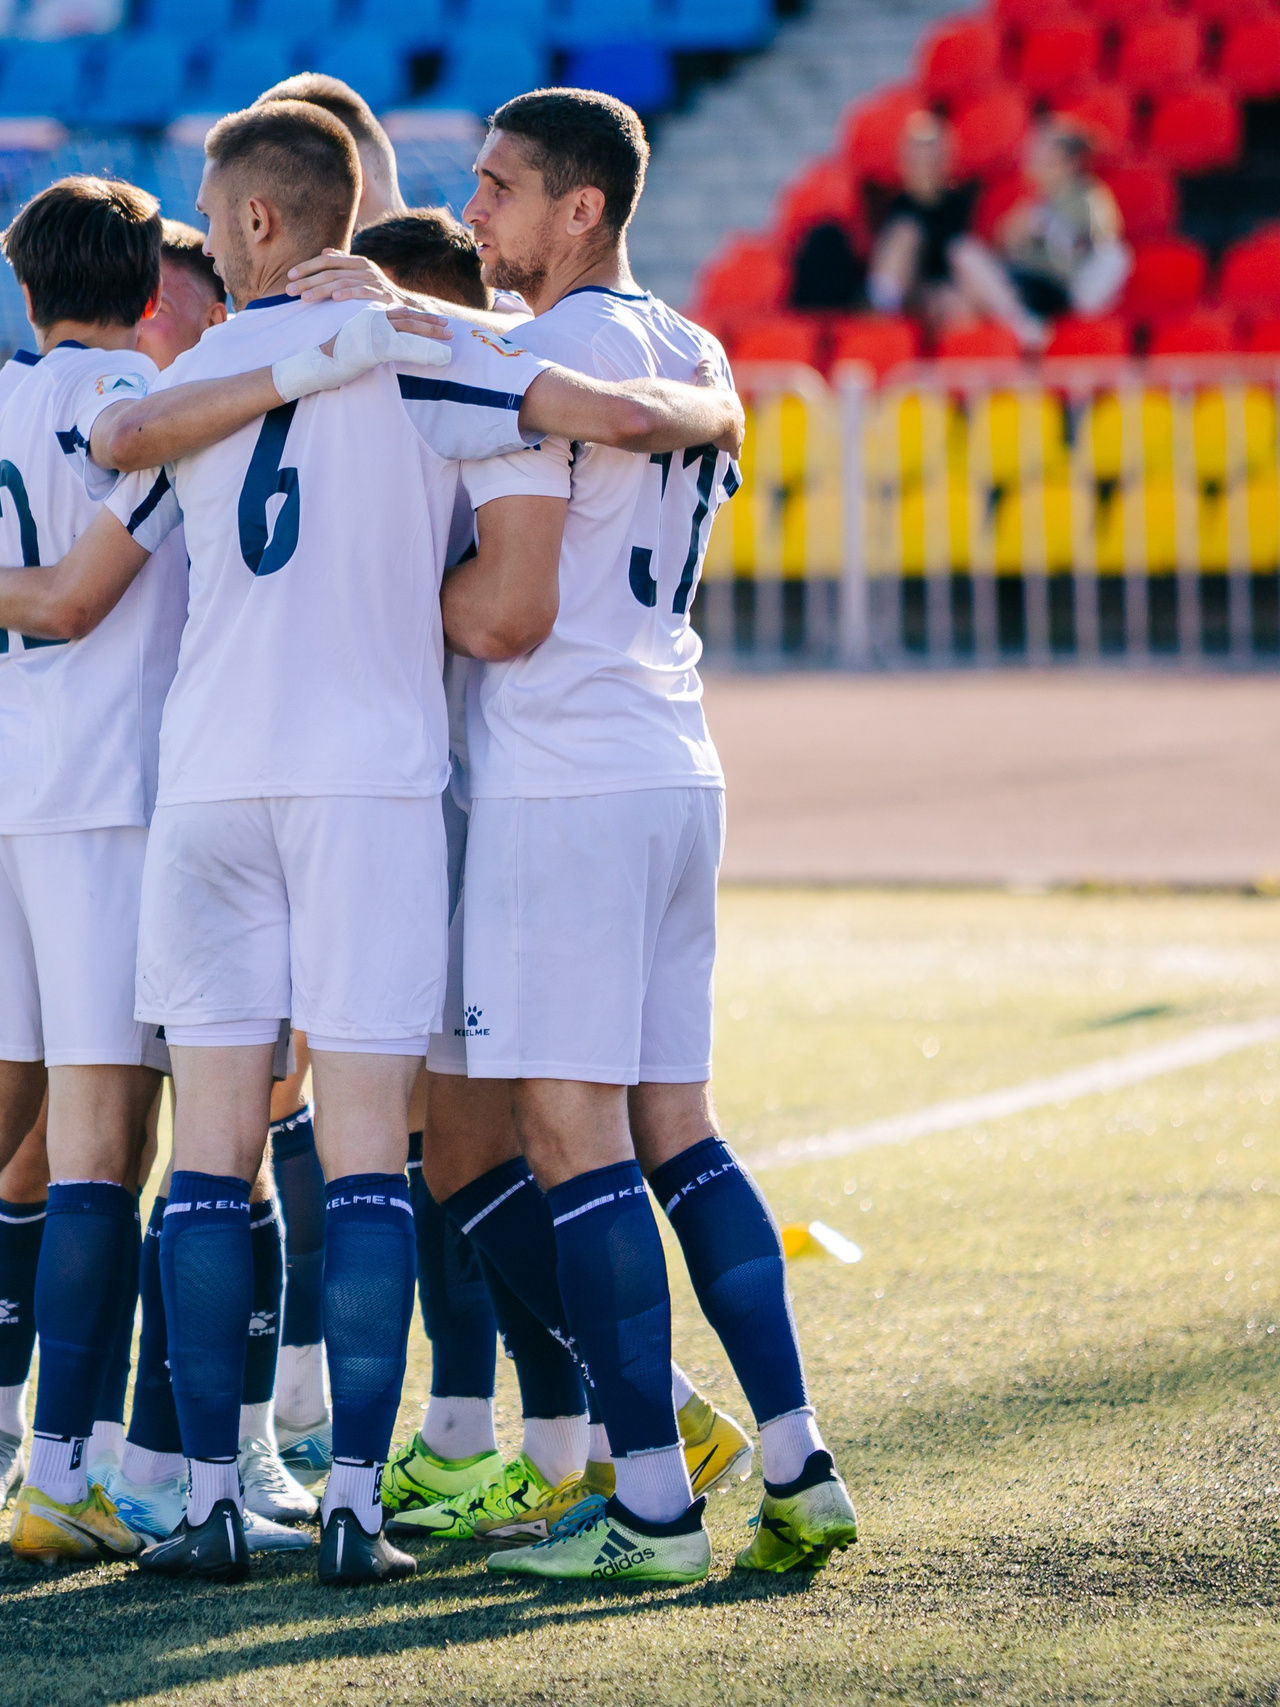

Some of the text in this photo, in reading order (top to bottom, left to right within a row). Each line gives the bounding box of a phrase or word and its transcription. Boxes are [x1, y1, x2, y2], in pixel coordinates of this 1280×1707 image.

[238, 399, 300, 576] 6
[681, 1162, 738, 1196] KELM
[196, 1200, 250, 1213] KELM
[590, 1547, 656, 1580] adidas
